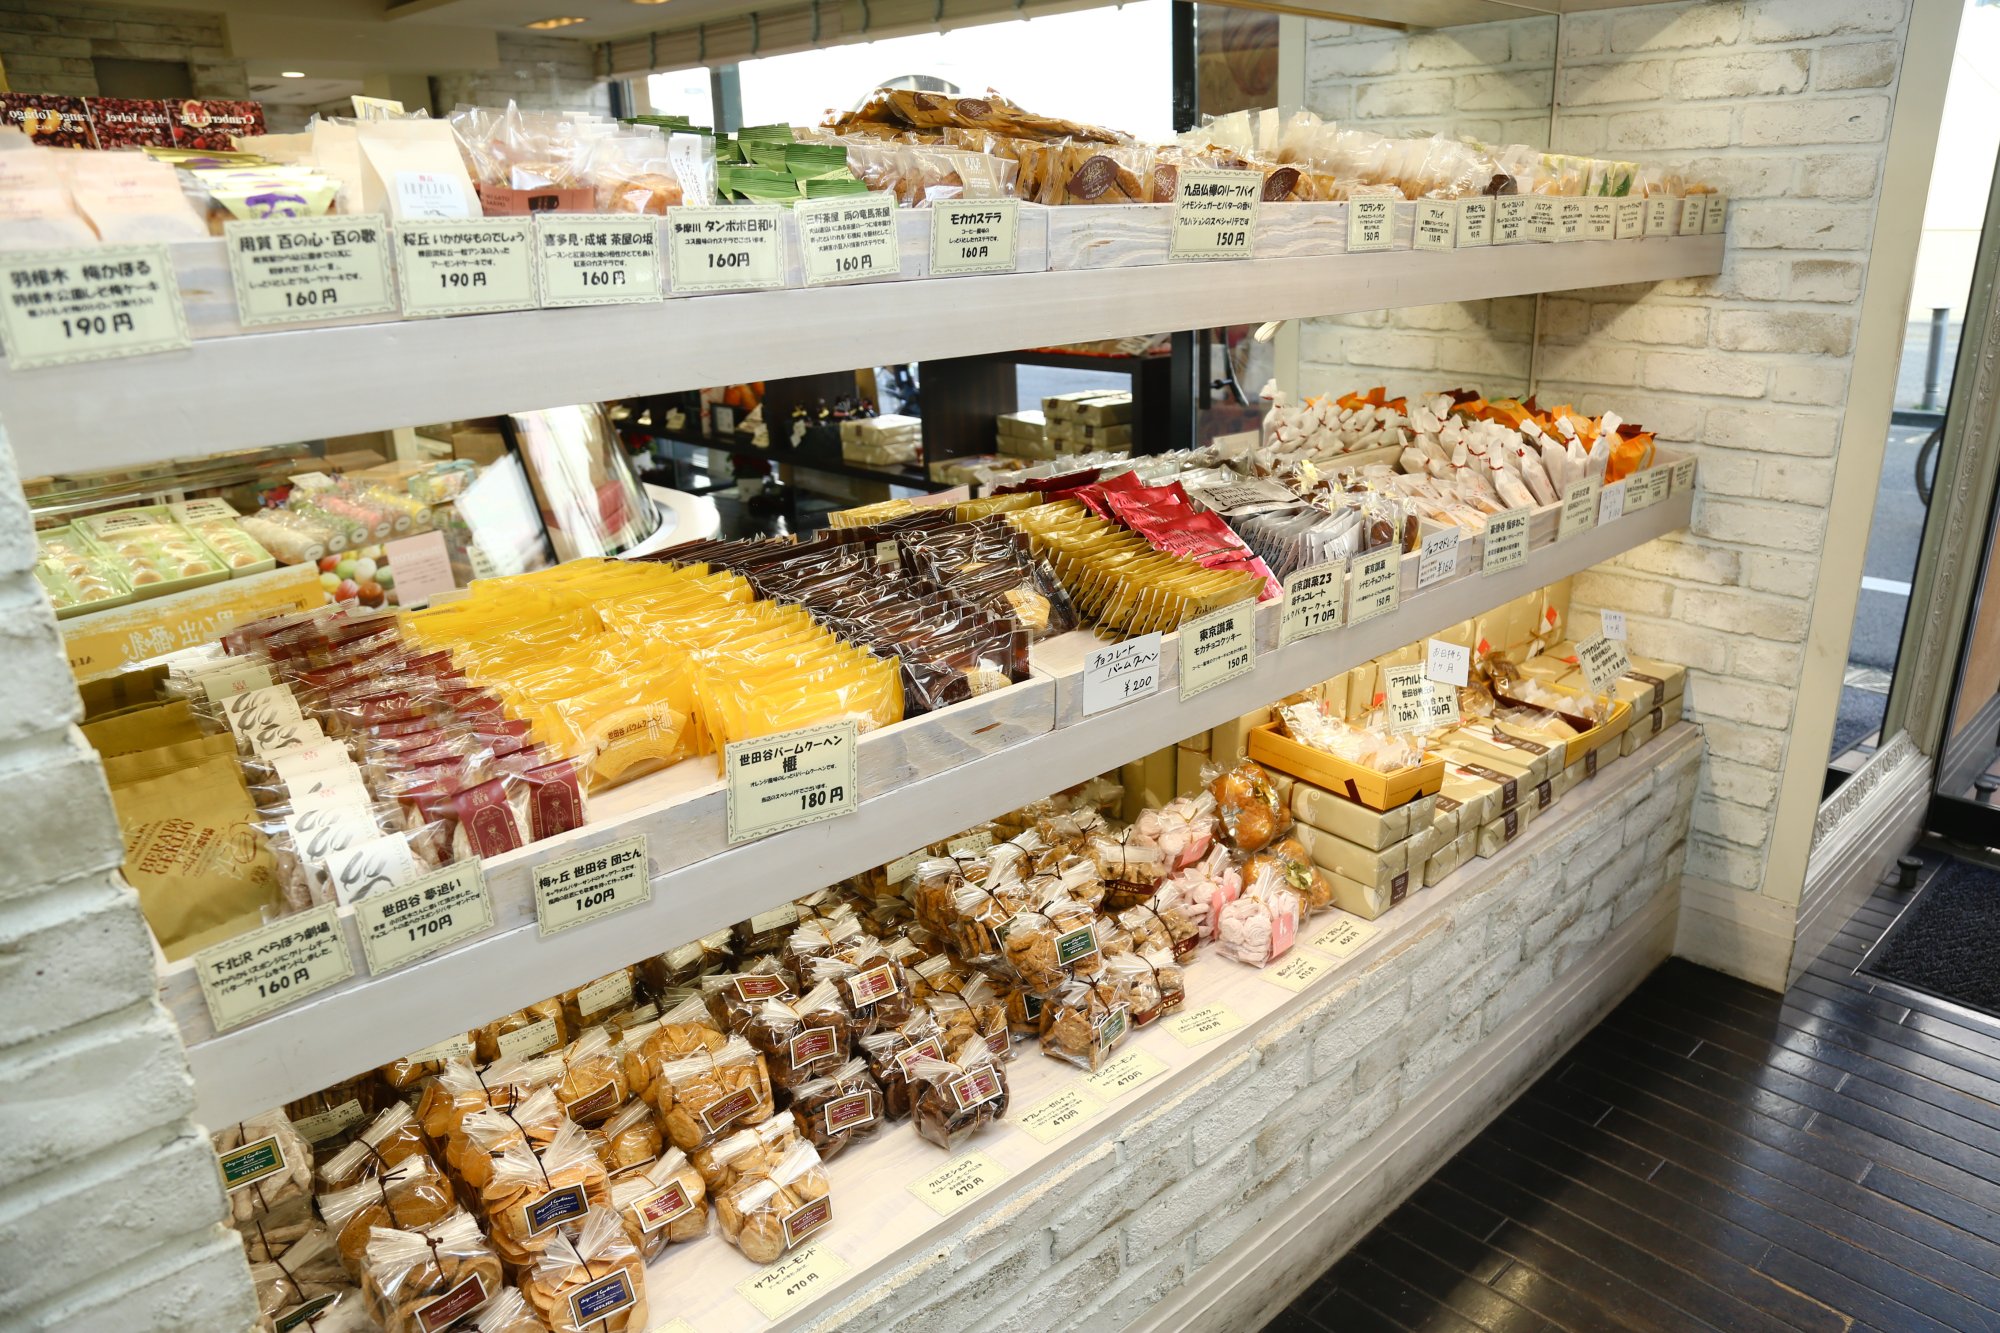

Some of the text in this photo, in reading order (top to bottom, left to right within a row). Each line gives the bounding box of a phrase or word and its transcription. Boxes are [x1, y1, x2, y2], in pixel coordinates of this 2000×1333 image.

[674, 219, 777, 234] 多摩川 タンポポ日和り
[806, 212, 839, 225] 三軒茶屋
[950, 212, 1002, 225] モカカステラ
[239, 229, 376, 252] 用賀 百の心・百の歌
[403, 232, 525, 246] 桜丘 いかがなものでしょう
[544, 232, 653, 247] 喜多見・成城 茶屋の坂
[1217, 232, 1245, 246] 150円
[1364, 231, 1380, 241] 150円
[708, 252, 750, 268] 160円
[962, 246, 988, 258] 160円
[836, 254, 873, 272] 160円
[10, 260, 152, 288] 羽根木 梅かほる
[441, 272, 487, 287] 190円
[582, 270, 626, 286] 160円
[285, 288, 338, 307] 160円
[62, 312, 135, 338] 190円
[1376, 594, 1391, 607] 150円
[1304, 608, 1335, 627] 170円
[1194, 633, 1242, 656] モカチョコクッキー
[1094, 644, 1136, 669] チョコレート
[1228, 653, 1248, 670] 150円
[1391, 673, 1421, 688] アラカルト
[740, 735, 842, 767] 世田谷バームクーヘン
[802, 786, 844, 810] 180円
[573, 858, 608, 878] 世田谷
[611, 848, 642, 867] 団さん
[382, 878, 462, 918] 世田谷 夢追い
[576, 888, 615, 911] 160円
[408, 913, 453, 941] 170円
[211, 951, 254, 975] 下北沢
[258, 967, 310, 998] 160円
[1117, 1070, 1143, 1087] 470円
[1053, 1109, 1079, 1127] 470円
[955, 1176, 984, 1197] 470円
[754, 1247, 817, 1289] サブレアーモンド
[786, 1272, 819, 1296] 470円
